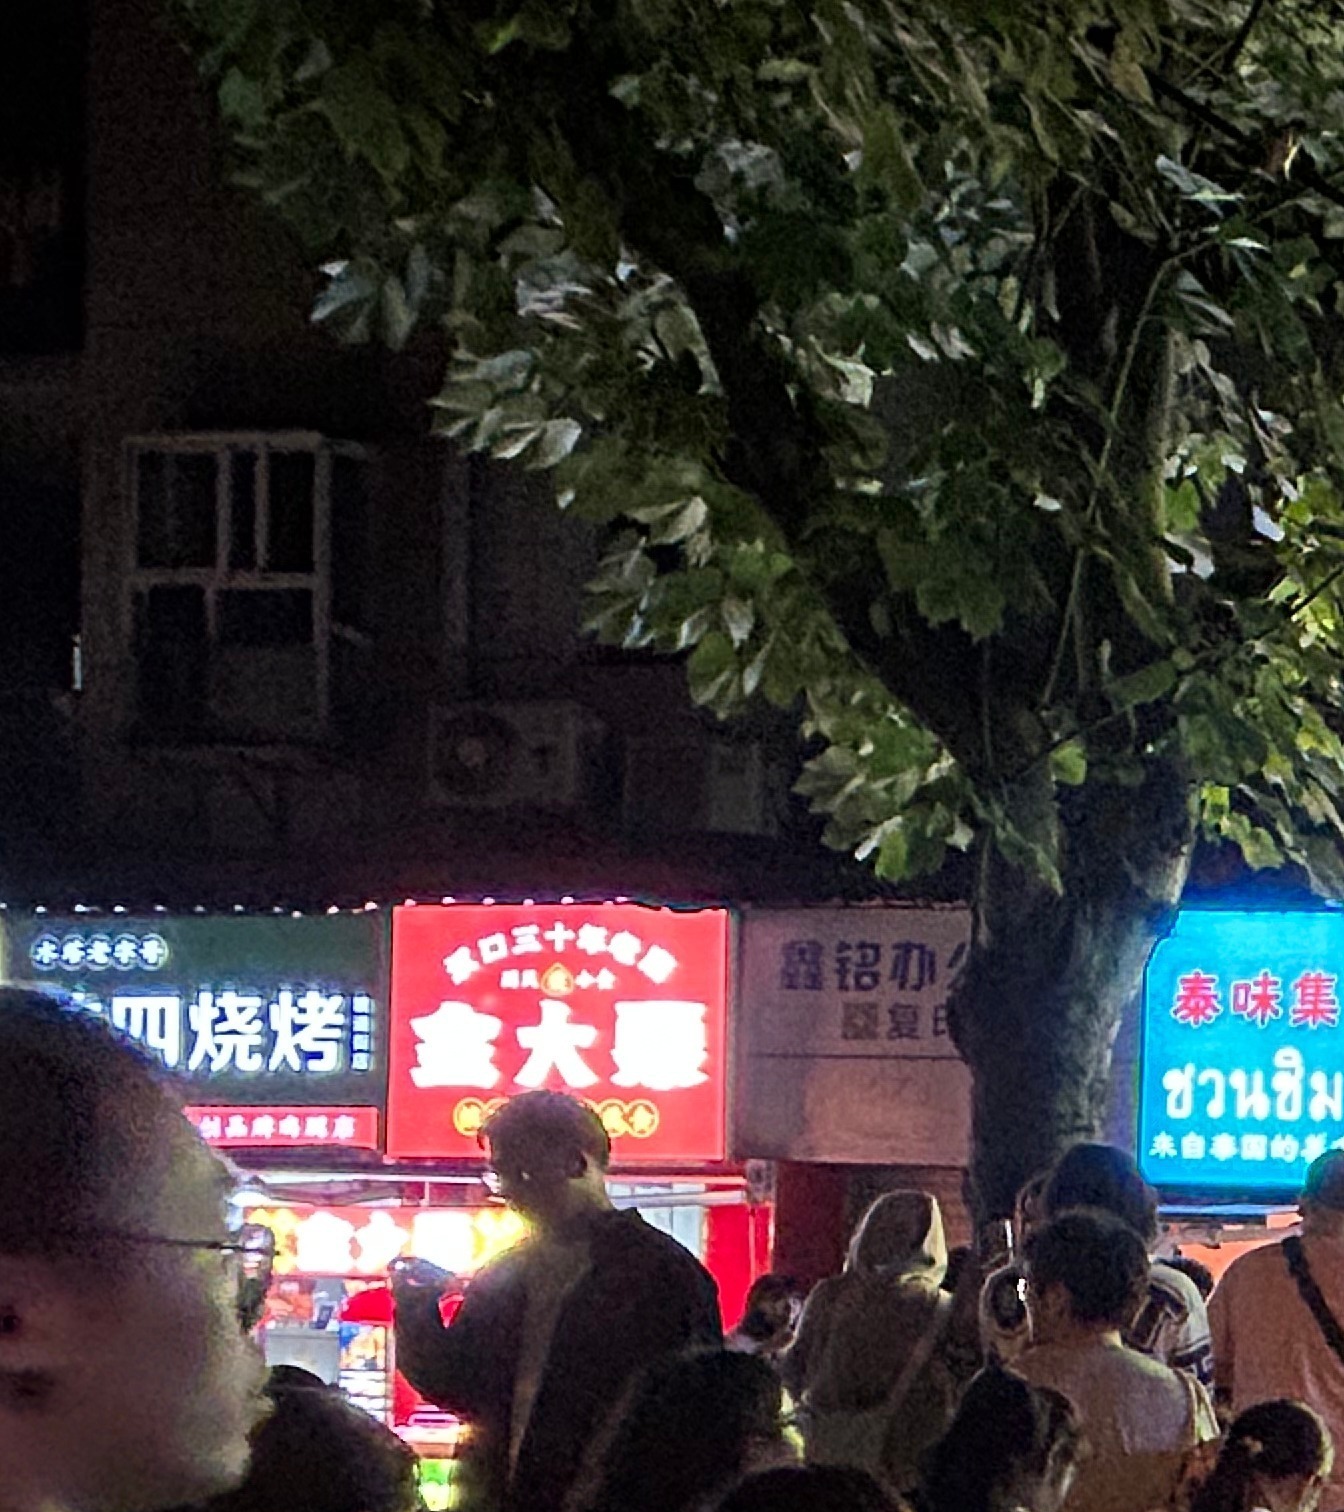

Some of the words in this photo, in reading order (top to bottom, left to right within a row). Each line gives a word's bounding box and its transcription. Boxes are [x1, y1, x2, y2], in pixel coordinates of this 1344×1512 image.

[74, 984, 346, 1073] 四烧烤
[1171, 969, 1341, 1029] 泰味集
[1162, 1045, 1344, 1122] ชวนชิม
